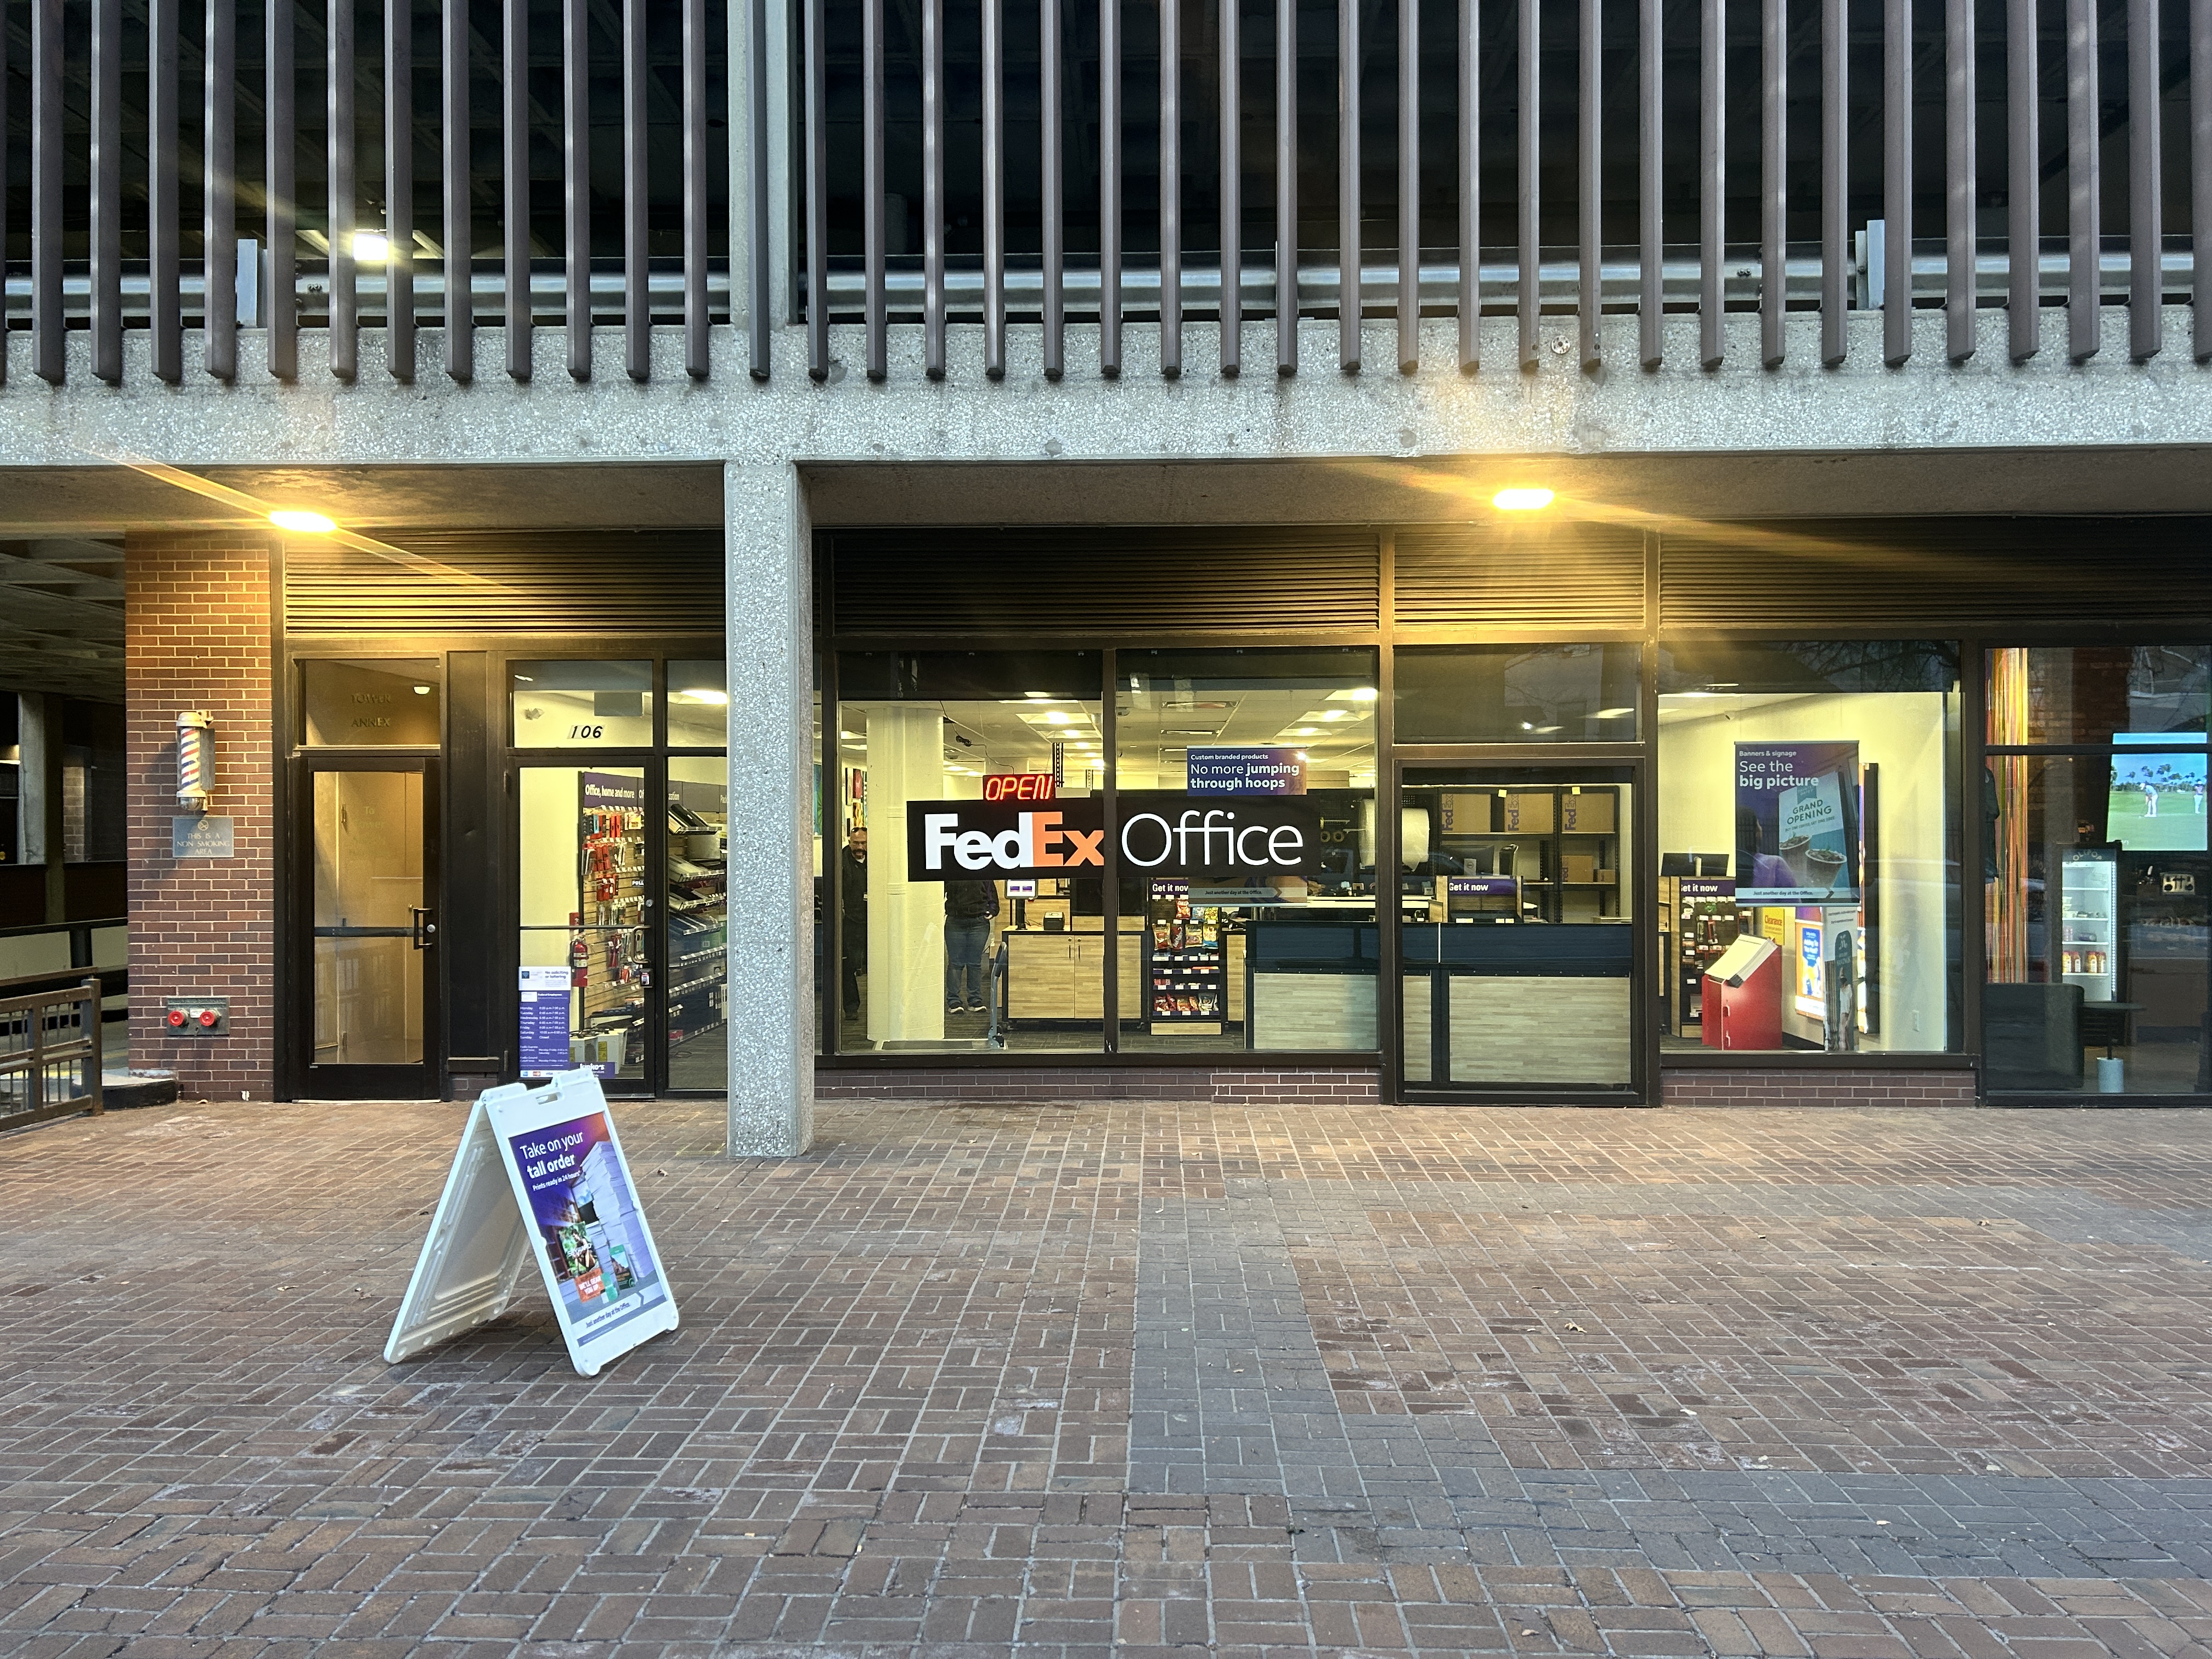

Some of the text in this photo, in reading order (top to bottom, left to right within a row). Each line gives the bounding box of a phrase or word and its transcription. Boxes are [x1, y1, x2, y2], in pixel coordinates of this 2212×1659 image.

[351, 694, 391, 703] TOWER
[351, 718, 391, 727] ANNEX
[571, 725, 603, 739] 106
[1190, 763, 1300, 776] No more jumping
[1739, 760, 1793, 772] See the
[985, 775, 1053, 800] OPEN
[1190, 777, 1285, 791] through hoops
[1739, 774, 1819, 790] big picture
[585, 784, 601, 798] Office,
[601, 785, 614, 797] home
[614, 787, 623, 798] and
[623, 789, 635, 799] more
[1442, 794, 1453, 831] FedEx
[1508, 794, 1519, 831] FedEx
[1565, 794, 1576, 831] FedEx
[1792, 799, 1823, 814] GRAND
[1787, 805, 1832, 825] OPENING
[924, 810, 1304, 870] FedEx Office
[1152, 883, 1165, 892] Get
[1167, 883, 1173, 891] it
[1449, 883, 1462, 891] Get
[1464, 882, 1470, 891] it
[1692, 883, 1699, 892] it
[1764, 915, 1782, 926] Clearance
[520, 1132, 583, 1160] Take on your
[527, 1154, 575, 1179] tall order
[532, 1183, 546, 1192] Prints
[545, 1178, 558, 1187] ready
[592, 1315, 605, 1324] another
